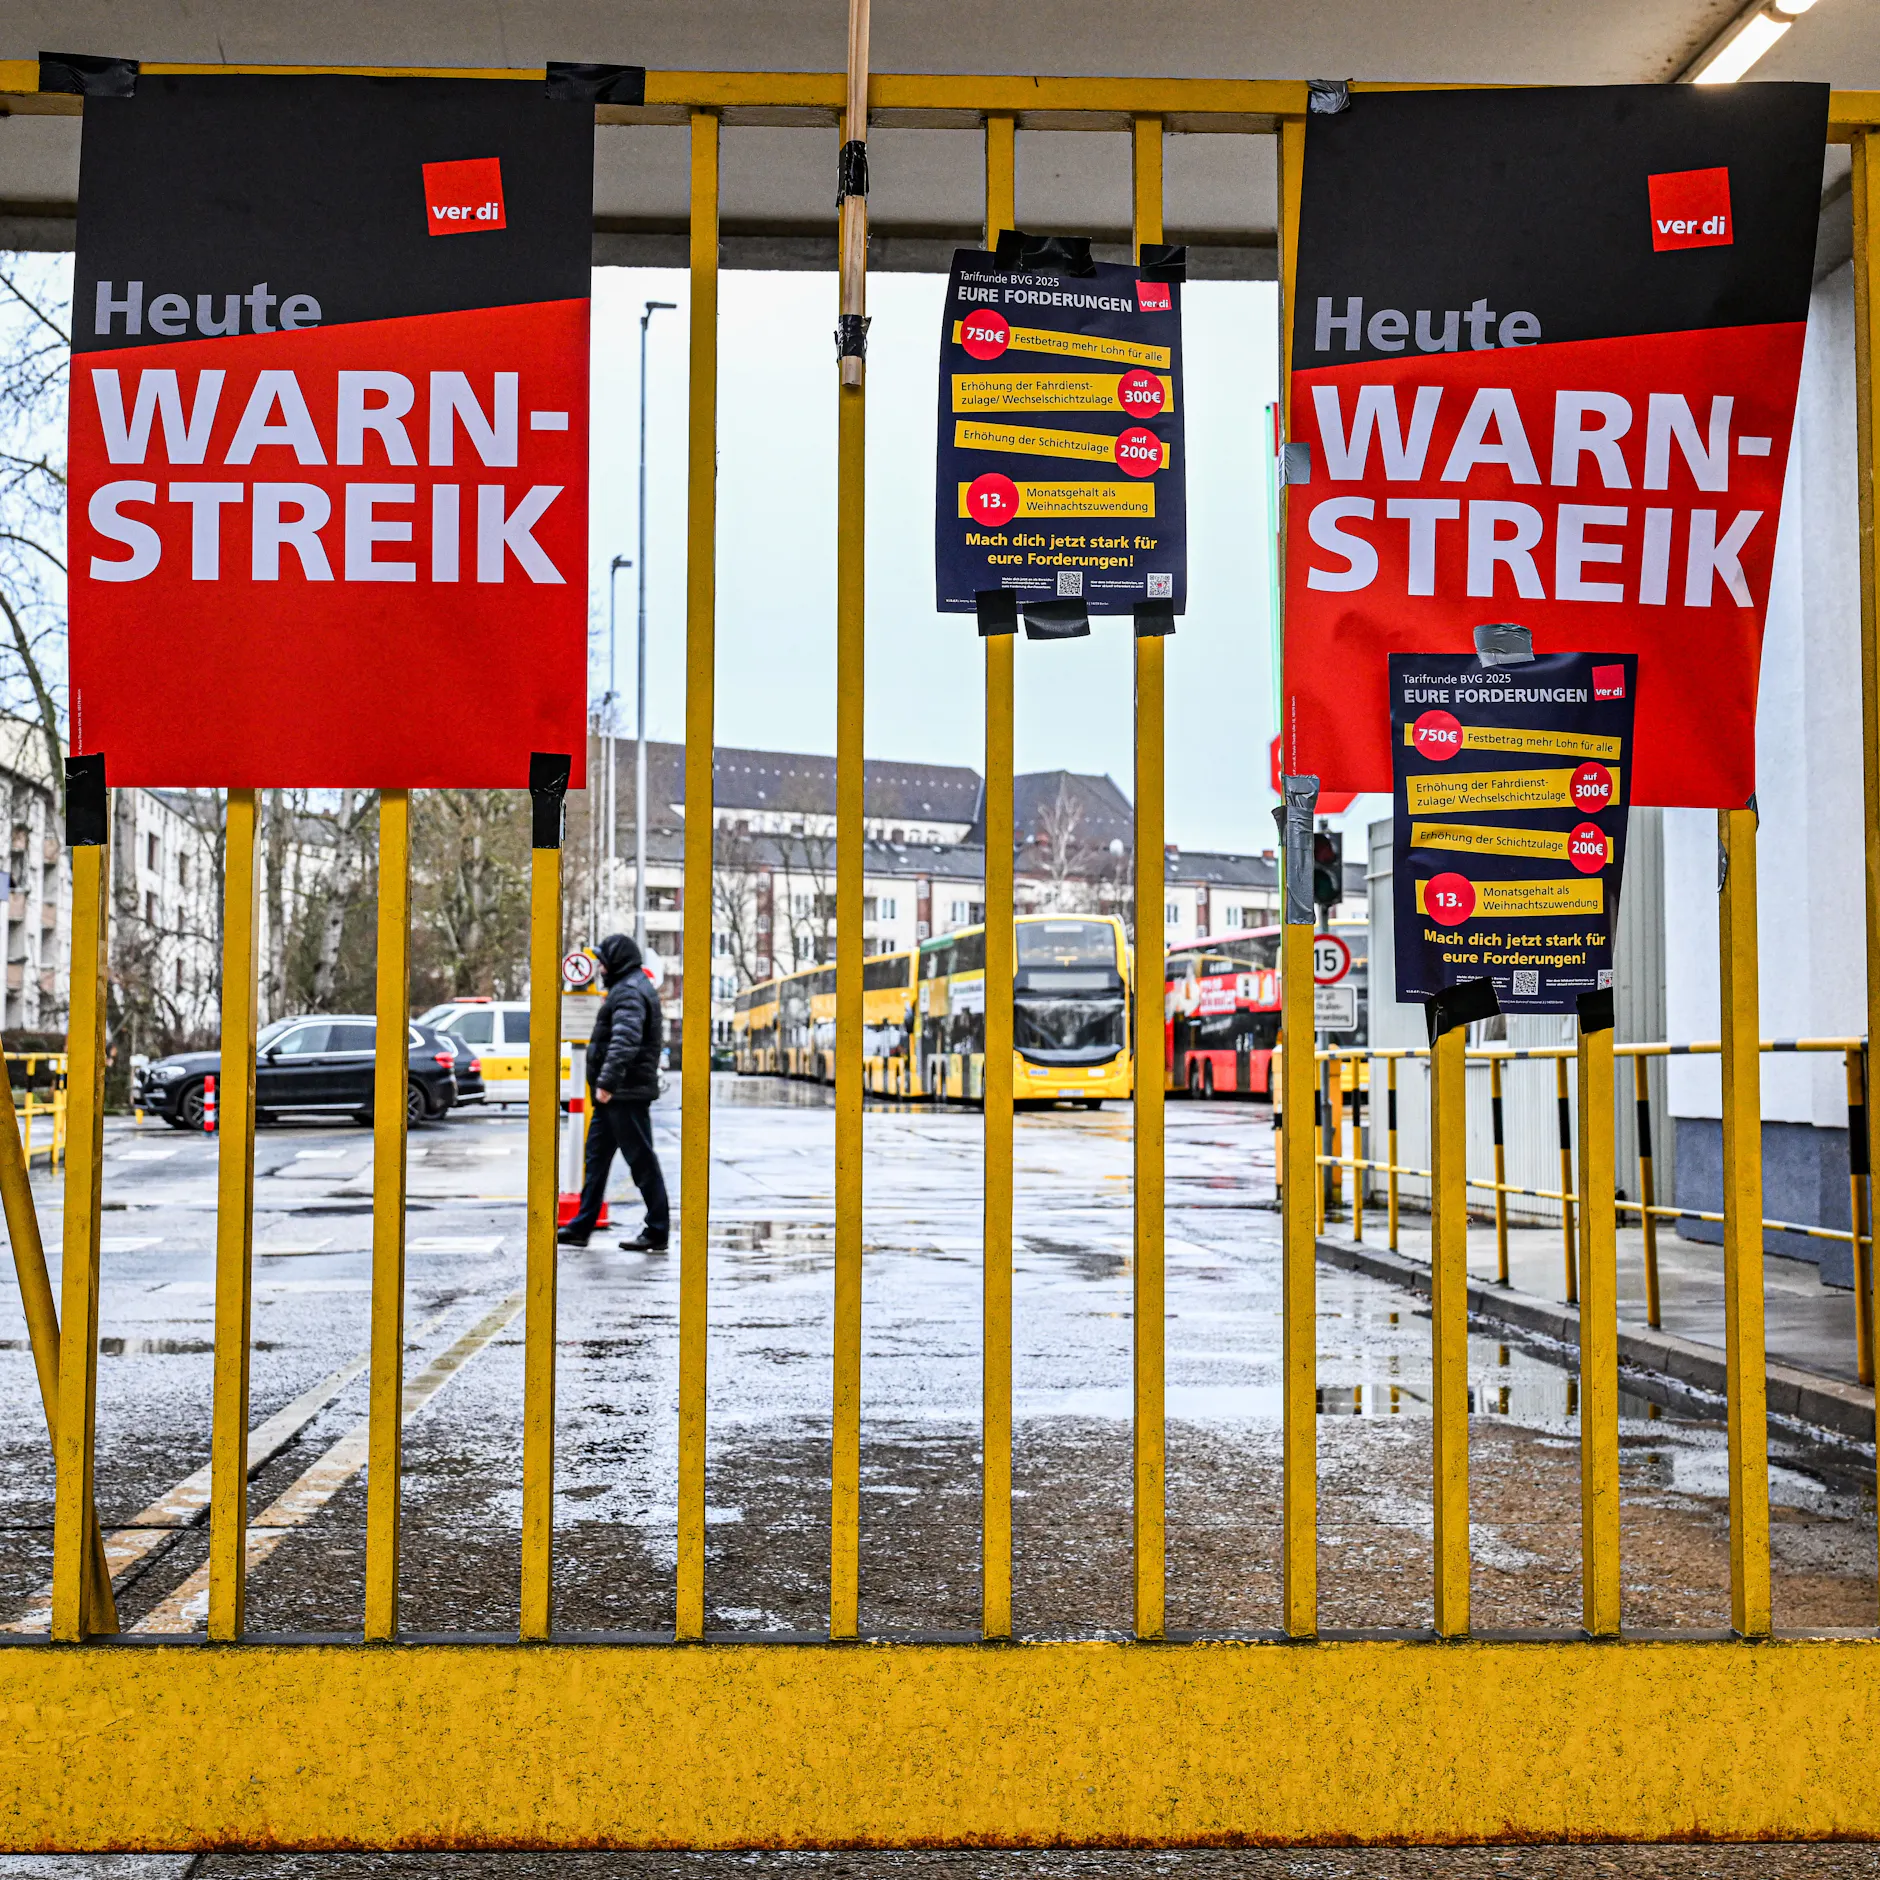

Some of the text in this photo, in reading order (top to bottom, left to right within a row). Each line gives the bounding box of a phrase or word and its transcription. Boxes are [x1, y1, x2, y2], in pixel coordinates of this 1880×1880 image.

[432, 202, 499, 222] ver.di
[1656, 215, 1725, 236] ver.di
[960, 271, 1059, 287] Tarifrunde BVG 2025
[958, 286, 1132, 312] EURE FORDERUNGEN
[1141, 299, 1169, 308] ver.di
[94, 281, 322, 336] Heute
[1314, 296, 1542, 352] Heute
[966, 327, 1005, 343] 750€
[1015, 334, 1162, 361] Festbetrag mehr Lohn für alle
[961, 381, 1093, 392] Erhöhung der Fahrdienst-
[962, 395, 1113, 406] zulage/ Wechselschichtzulage
[1125, 391, 1161, 403] 300€
[91, 369, 569, 467] WARN-
[964, 429, 1109, 454] Erhöhung der Schichtzulage
[1131, 435, 1146, 444] auf
[1311, 385, 1772, 492] WARN-
[1120, 445, 1157, 461] 200€
[980, 494, 1006, 508] 13.
[1027, 488, 1115, 499] Monatsgehalt als
[1027, 501, 1148, 513] Weihnachtszuwendung
[87, 480, 567, 584] STREIK
[966, 533, 1157, 550] Mach dich jetzt stark für
[1306, 496, 1764, 608] STREIK
[987, 553, 1134, 569] eure Forderungen!
[1403, 674, 1511, 684] Tarifrunde BVG 2025
[1404, 689, 1587, 703] EURE FORDERUNGEN
[1419, 729, 1457, 743] 750€
[1468, 734, 1613, 752] Festbetrag mehr Lohn für alle
[1583, 773, 1597, 781] auf
[1416, 778, 1548, 793] Erhöhung der Fahrdienst-
[1576, 784, 1608, 797] 300€
[1417, 792, 1566, 807] zulage/ Wechselschichtzulage
[1420, 832, 1563, 851] Erhöhung der Schichtzulage
[1581, 831, 1594, 839] auf
[1572, 841, 1603, 855] 200€
[1484, 886, 1569, 897] Monatsgehalt als
[1436, 893, 1462, 907] 13.
[1483, 899, 1598, 911] Weihnachtszuwendung
[1424, 929, 1605, 949] Mach dich jetzt stark für
[1314, 949, 1336, 972] 15
[1443, 952, 1586, 968] eure Forderungen!
